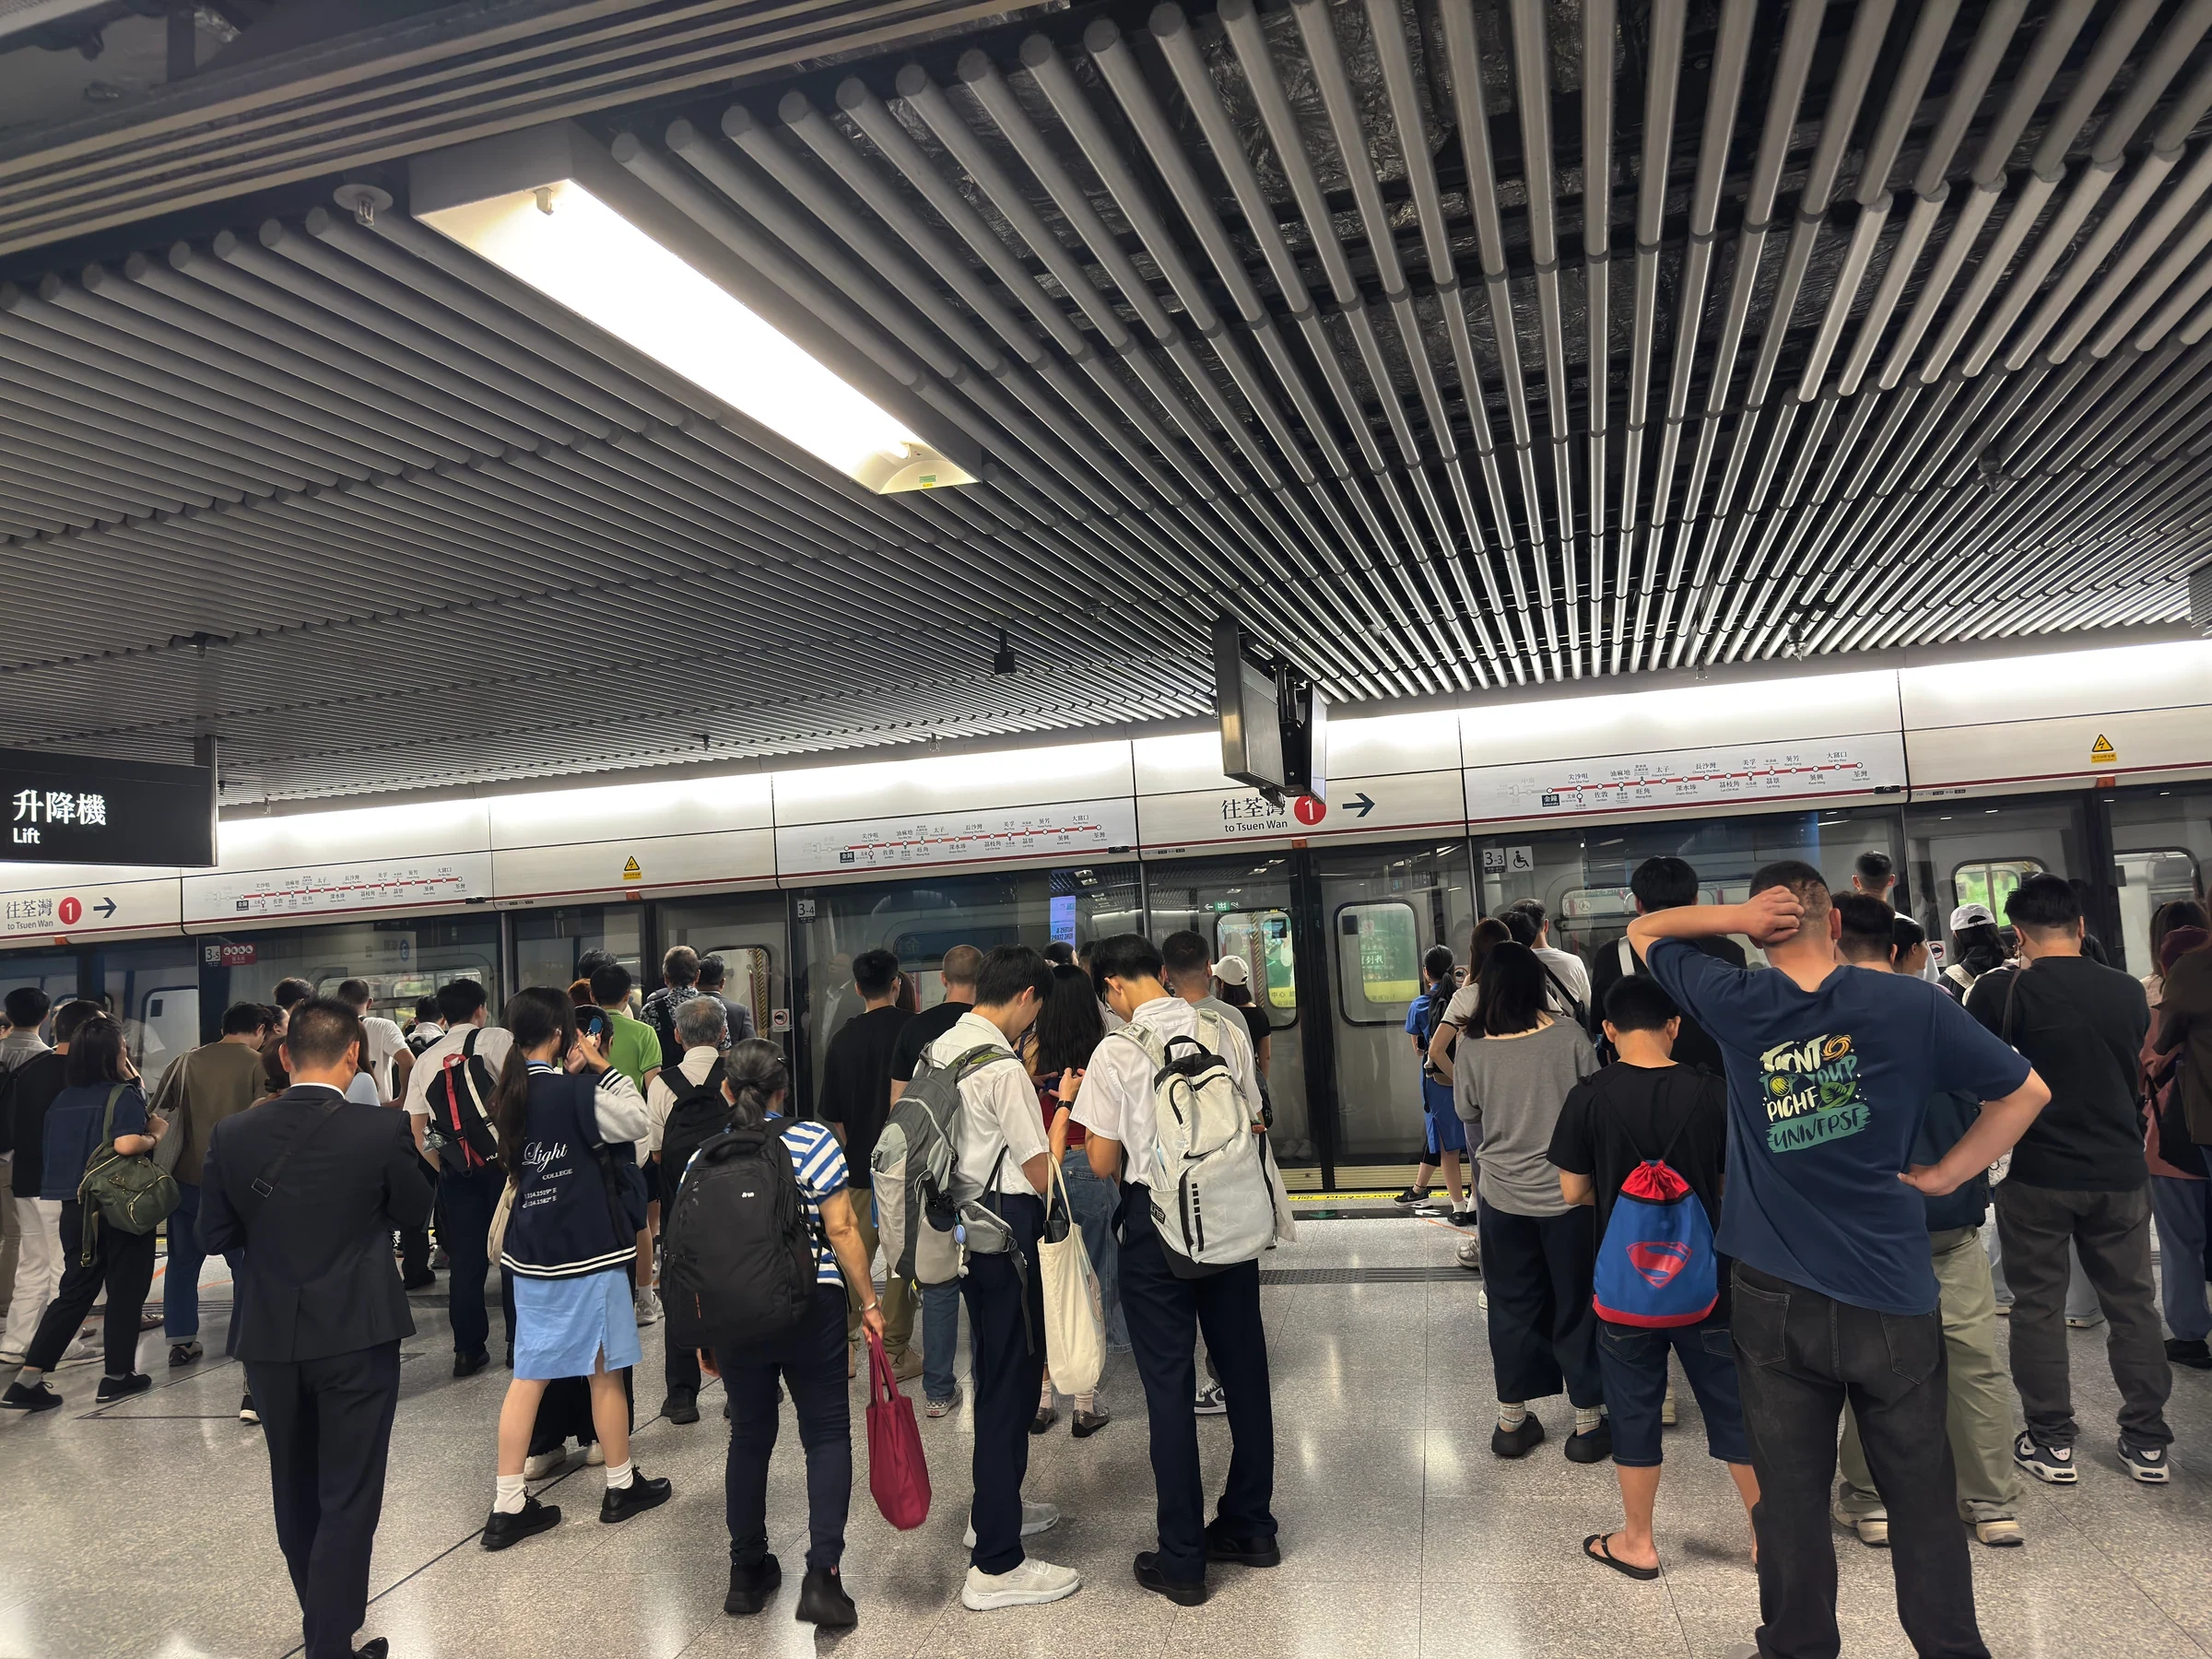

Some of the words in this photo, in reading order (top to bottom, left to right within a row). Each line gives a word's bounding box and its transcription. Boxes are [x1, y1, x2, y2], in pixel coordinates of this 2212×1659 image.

[13, 790, 106, 825] 升降機
[1305, 798, 1313, 820] 1
[1225, 824, 1234, 832] to
[1236, 822, 1264, 831] Tsuen
[1267, 820, 1288, 829] Wan
[13, 828, 40, 844] Lift
[1485, 852, 1503, 865] 3-3
[7, 898, 53, 919] 往荃灣
[66, 903, 73, 920] 1
[799, 904, 814, 915] 3-4
[16, 921, 36, 929] Tsuen
[38, 920, 53, 928] Wan
[522, 1142, 568, 1173] Light
[542, 1169, 573, 1180] COLLEGE
